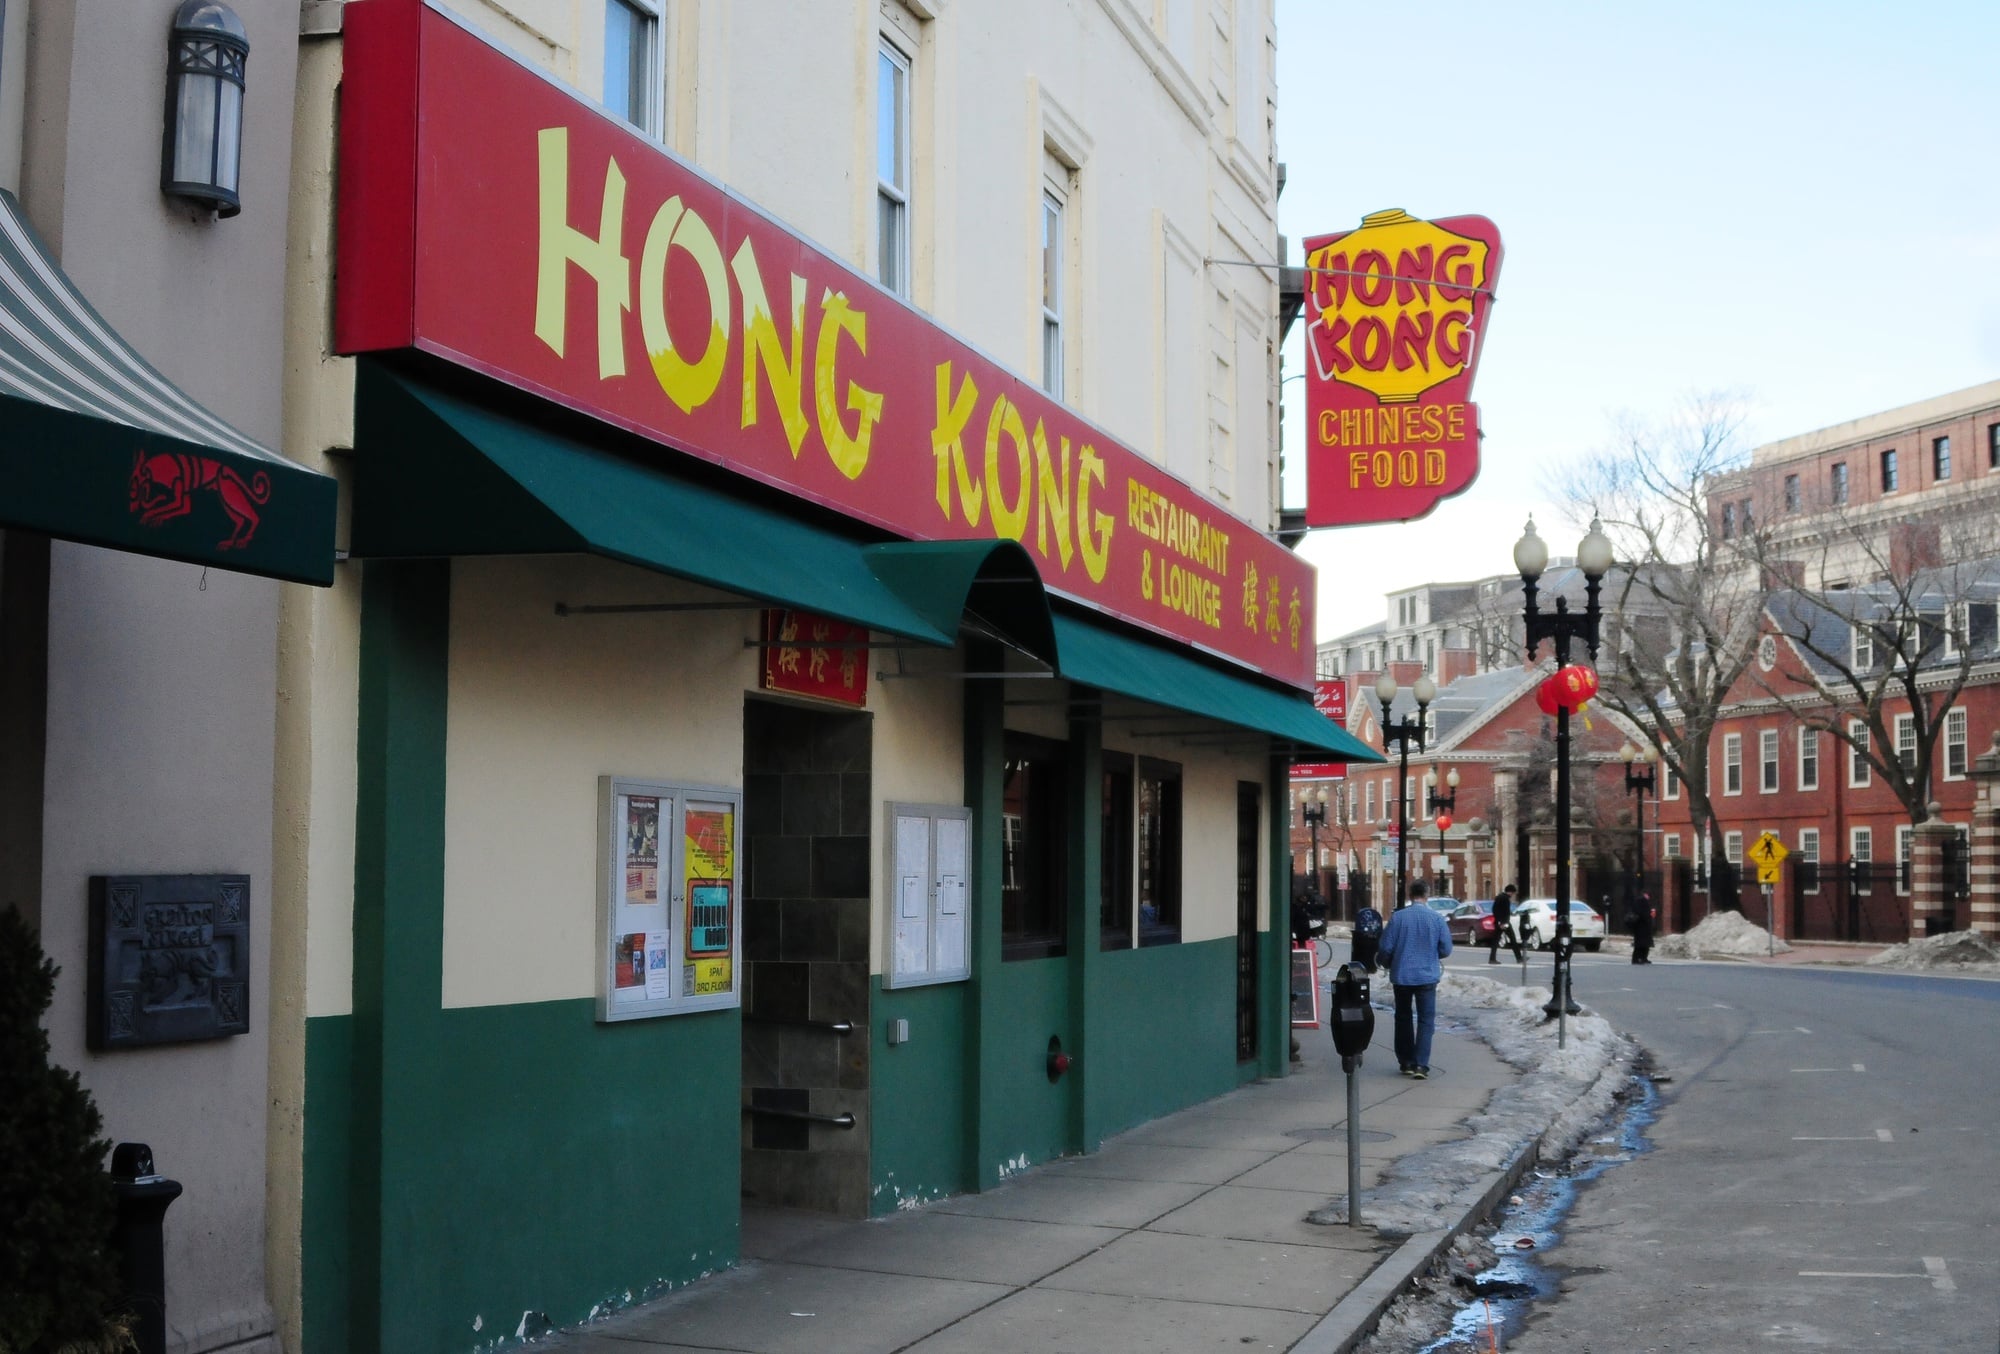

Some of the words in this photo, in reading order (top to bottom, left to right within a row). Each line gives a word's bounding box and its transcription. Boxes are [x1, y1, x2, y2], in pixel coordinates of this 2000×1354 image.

[1316, 243, 1475, 311] HONG
[535, 127, 884, 480] HONG
[931, 360, 1115, 584] KONG
[1311, 310, 1471, 374] KONG
[1318, 405, 1465, 447] CHINESE
[1350, 449, 1447, 489] FOOD
[1128, 477, 1230, 577] RESTAURANT
[1141, 549, 1153, 601] &
[1161, 564, 1221, 630] LOUNGE
[696, 983, 709, 992] 3RD
